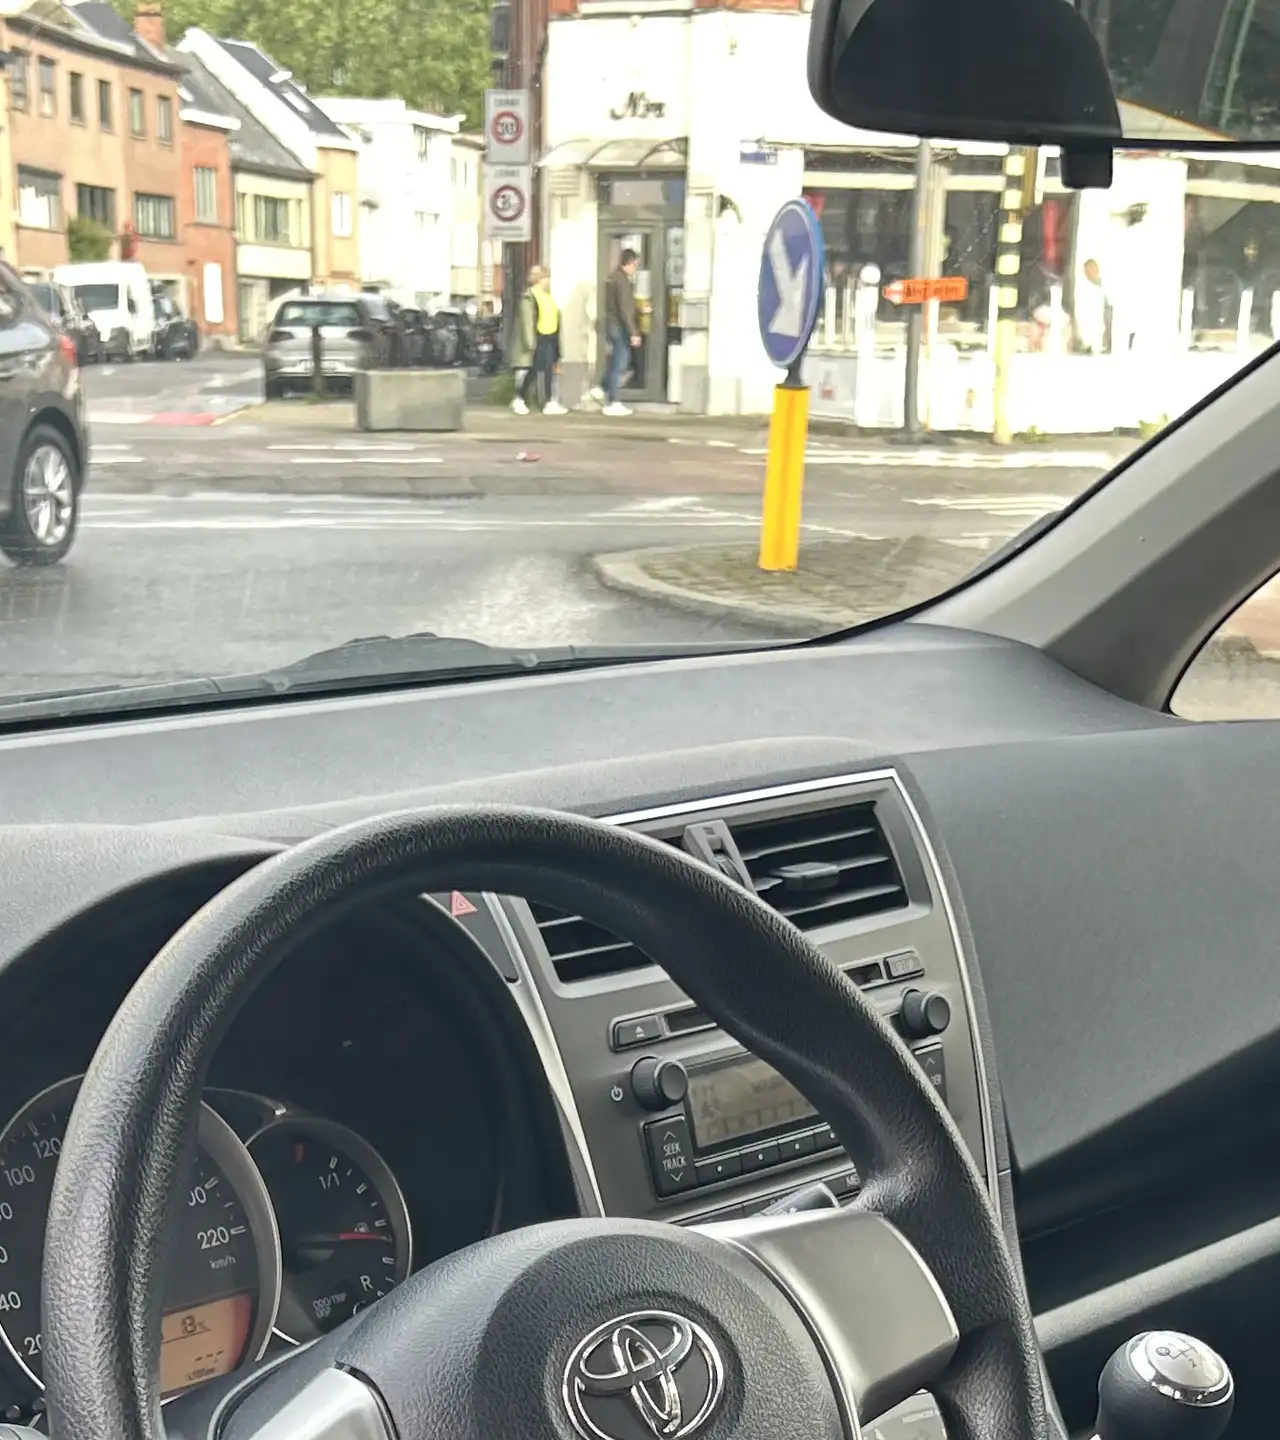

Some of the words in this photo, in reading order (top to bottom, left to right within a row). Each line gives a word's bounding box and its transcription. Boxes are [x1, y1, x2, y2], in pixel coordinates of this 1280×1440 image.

[32, 1137, 61, 1159] 120
[4, 1165, 35, 1187] 100
[196, 1226, 230, 1250] 220
[209, 1255, 236, 1270] km/h
[360, 1275, 374, 1292] R
